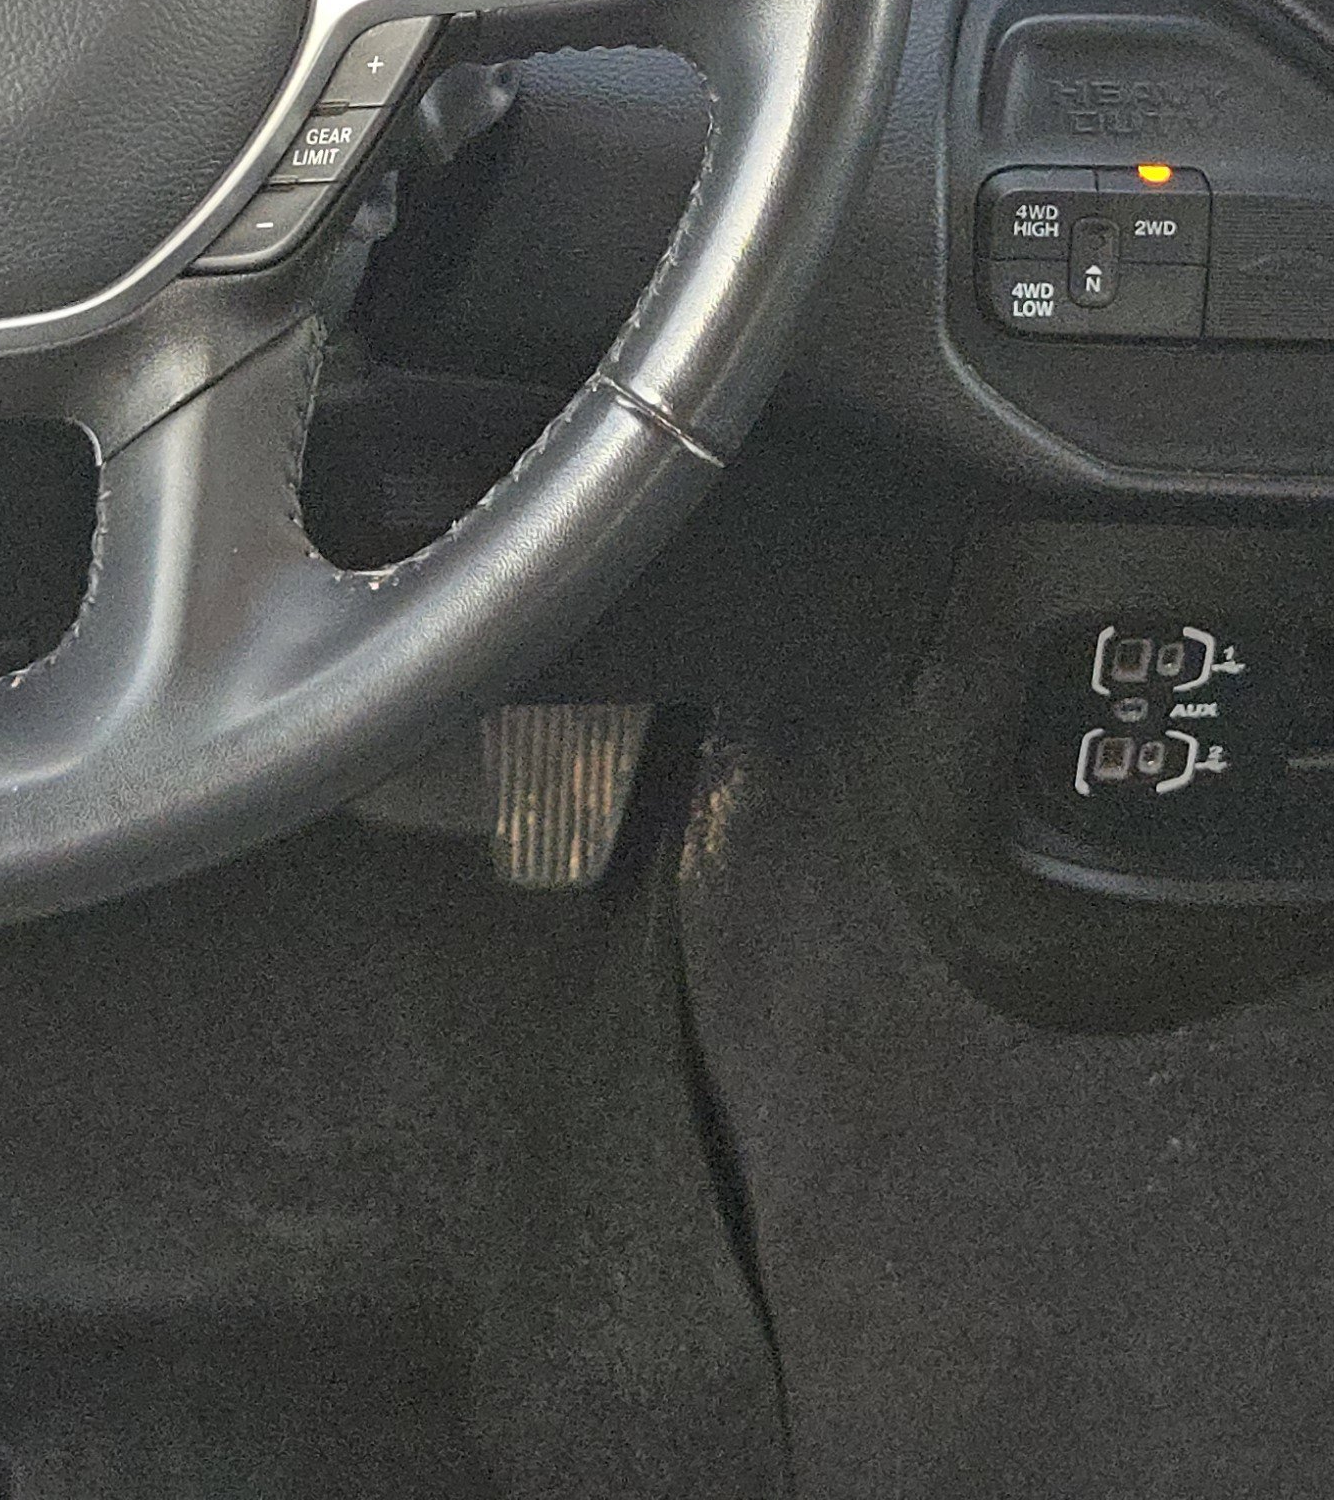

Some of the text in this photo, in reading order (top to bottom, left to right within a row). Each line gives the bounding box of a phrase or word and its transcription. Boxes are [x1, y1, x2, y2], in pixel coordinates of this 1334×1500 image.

[306, 127, 353, 145] GEAR
[292, 148, 340, 166] LIMIT
[1016, 205, 1059, 220] 4WD
[1013, 221, 1059, 238] HIGH
[1134, 220, 1177, 236] 2WD
[1011, 283, 1054, 299] 4WD
[1085, 276, 1101, 293] N
[1012, 301, 1055, 317] LOW
[1169, 702, 1218, 718] AUX
